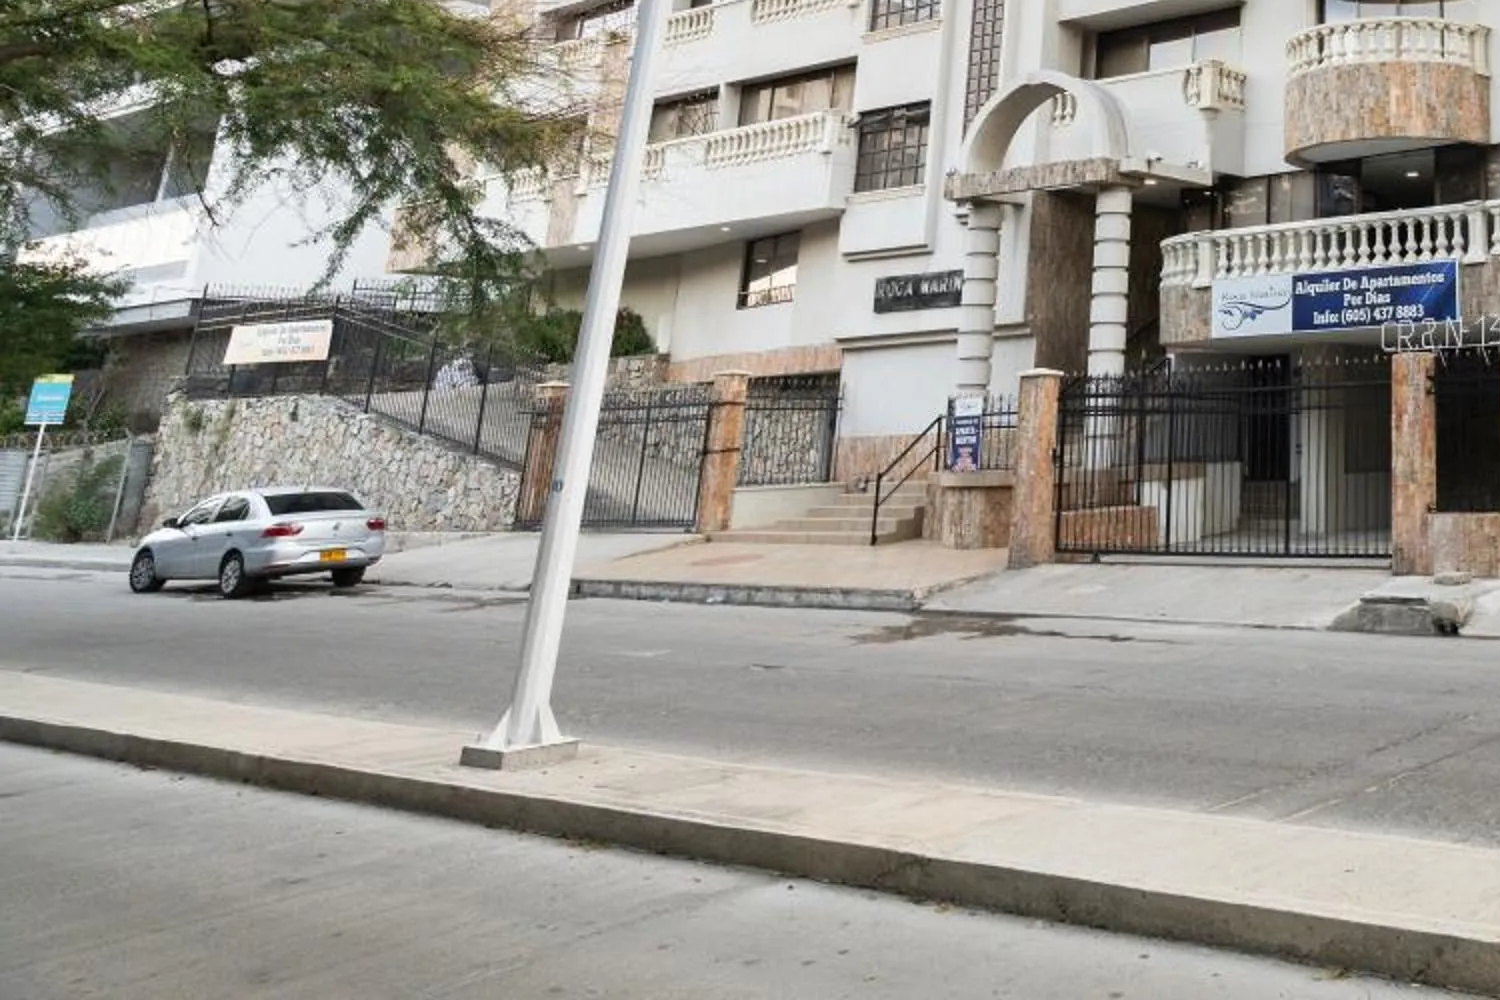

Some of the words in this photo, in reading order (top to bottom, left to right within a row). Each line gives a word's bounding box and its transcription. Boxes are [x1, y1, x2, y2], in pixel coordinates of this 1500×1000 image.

[921, 276, 962, 295] MARIN
[1295, 278, 1340, 296] Alquiler
[1343, 278, 1358, 291] De
[1360, 272, 1445, 292] Apartamentos
[1343, 293, 1363, 307] Por
[1313, 309, 1339, 325] Info:
[1341, 307, 1371, 325] (605)
[1373, 305, 1394, 319] 437
